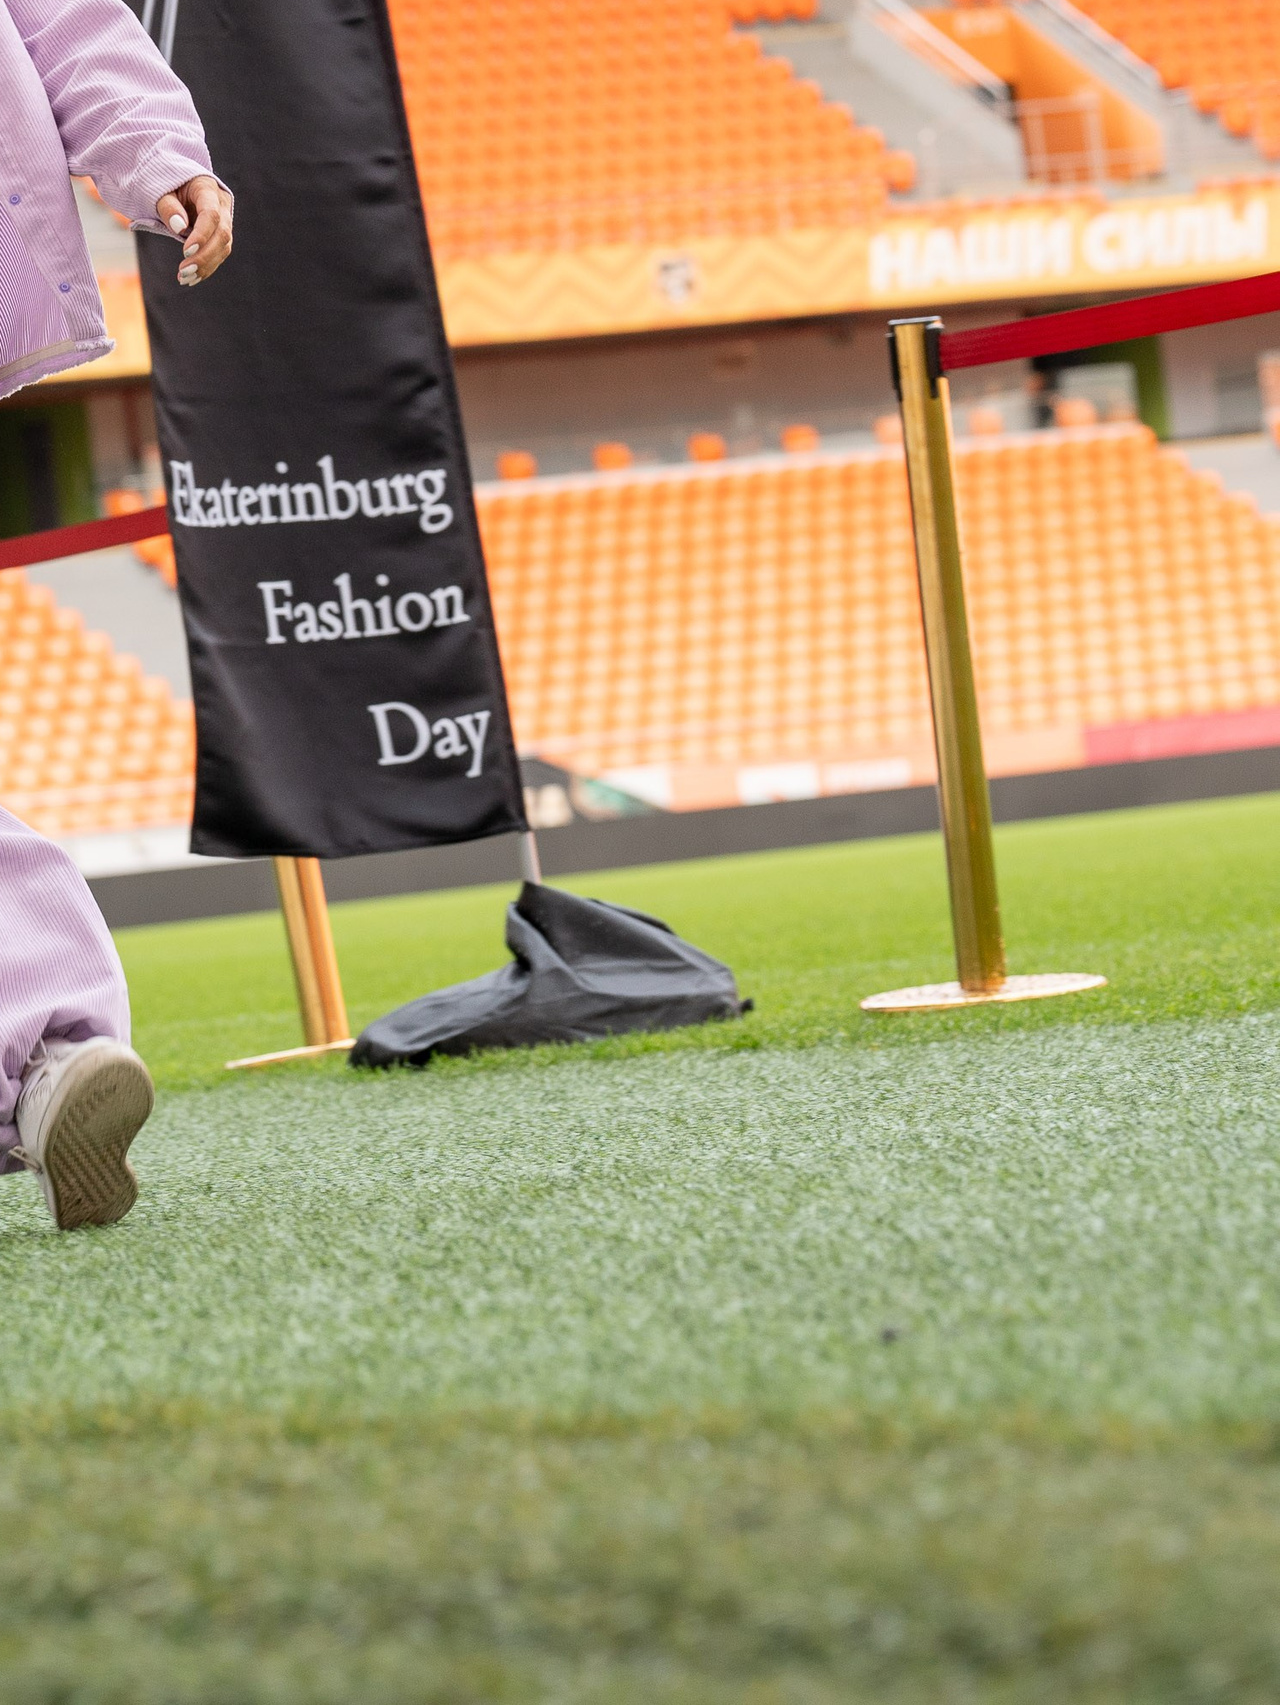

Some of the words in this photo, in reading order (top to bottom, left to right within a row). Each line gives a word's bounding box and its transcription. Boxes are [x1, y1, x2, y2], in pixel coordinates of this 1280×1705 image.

[868, 217, 1072, 294] НАШИ
[1082, 200, 1270, 273] СИЛЫ
[170, 455, 454, 534] Ekaterinburg
[257, 572, 471, 645] Fashion
[368, 701, 491, 778] Day
